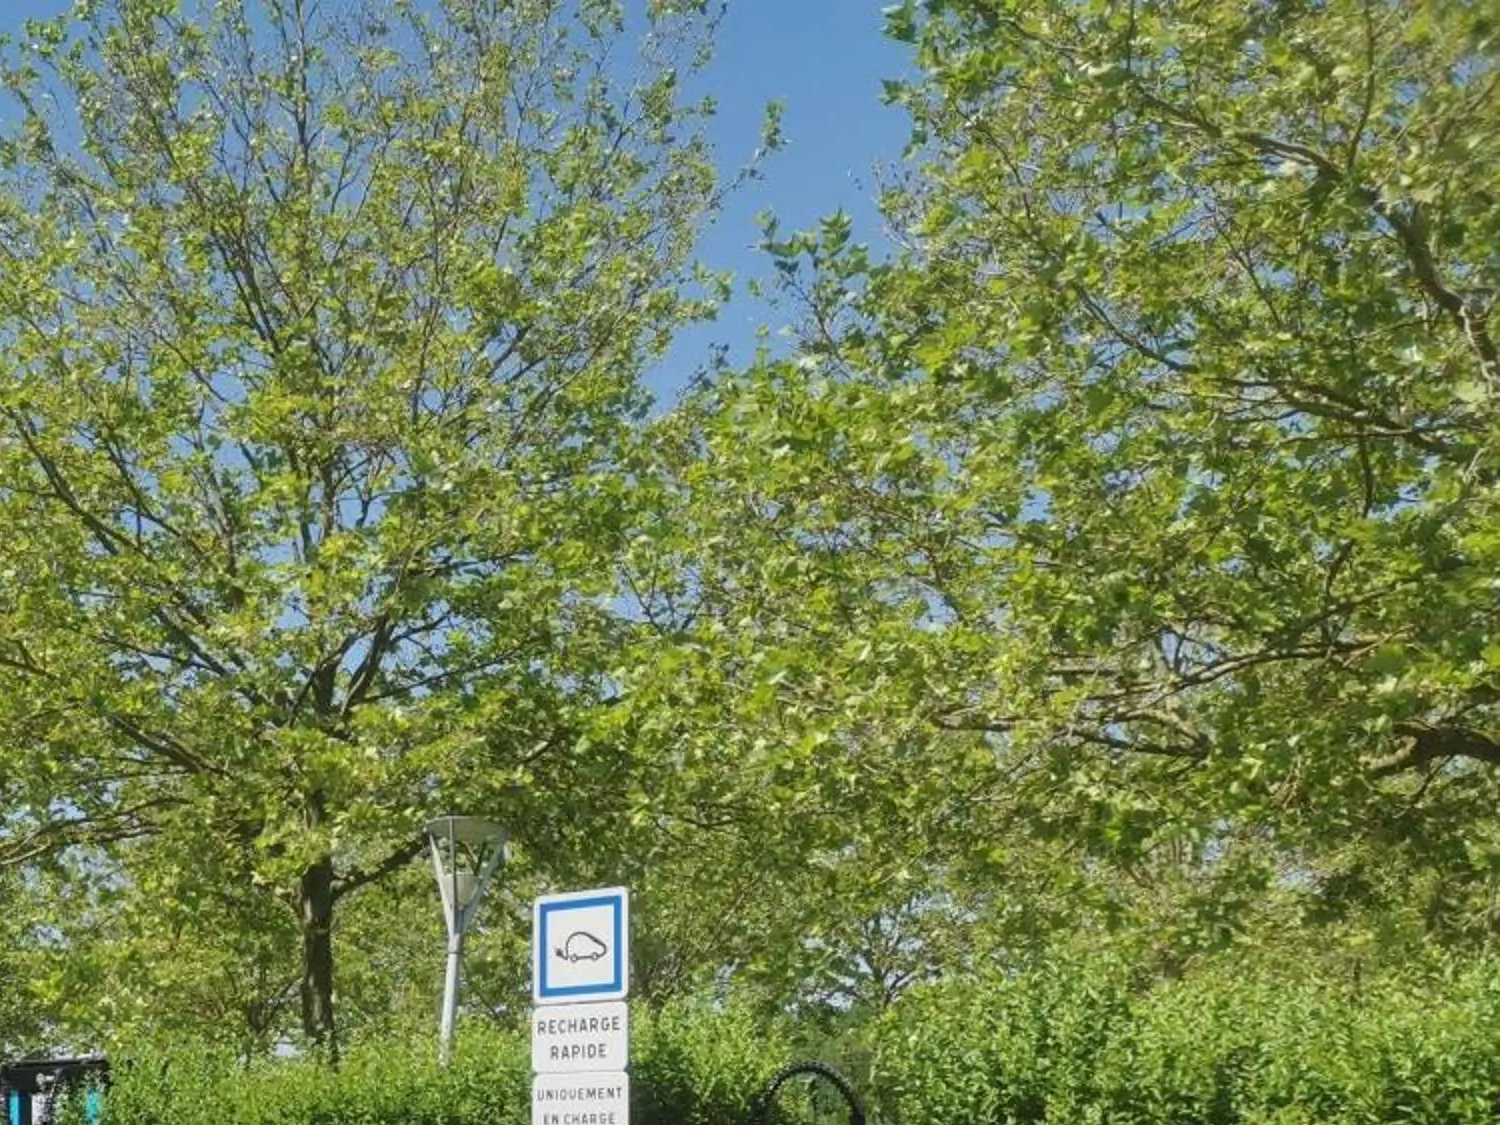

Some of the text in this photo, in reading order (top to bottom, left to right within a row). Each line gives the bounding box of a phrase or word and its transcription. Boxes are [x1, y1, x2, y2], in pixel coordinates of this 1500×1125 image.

[537, 1016, 621, 1035] RECHARGE
[550, 1043, 607, 1060] RAPIDE
[537, 1086, 622, 1101] UNIQUEMENT
[543, 1112, 617, 1125] EN CHARGE
